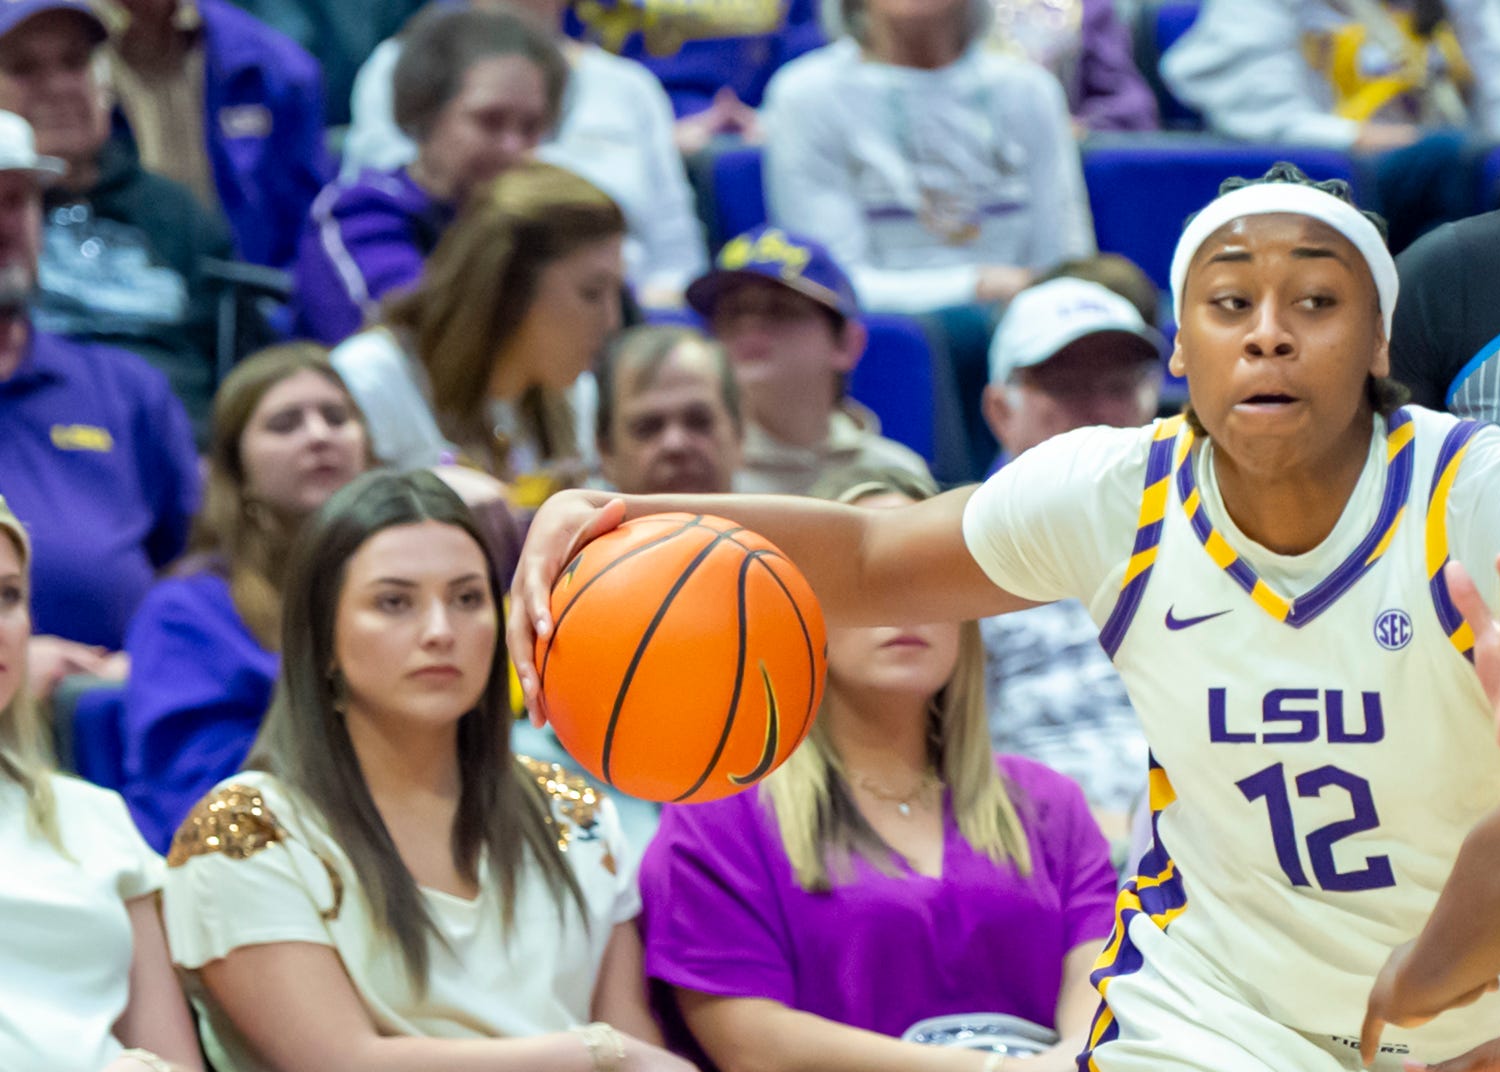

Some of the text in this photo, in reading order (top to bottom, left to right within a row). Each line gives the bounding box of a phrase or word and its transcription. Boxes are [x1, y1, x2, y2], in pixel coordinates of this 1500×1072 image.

[1379, 614, 1409, 646] SEC
[1207, 687, 1386, 745] LSU
[1234, 761, 1397, 892] 12
[1331, 1035, 1410, 1055] TIGRS
